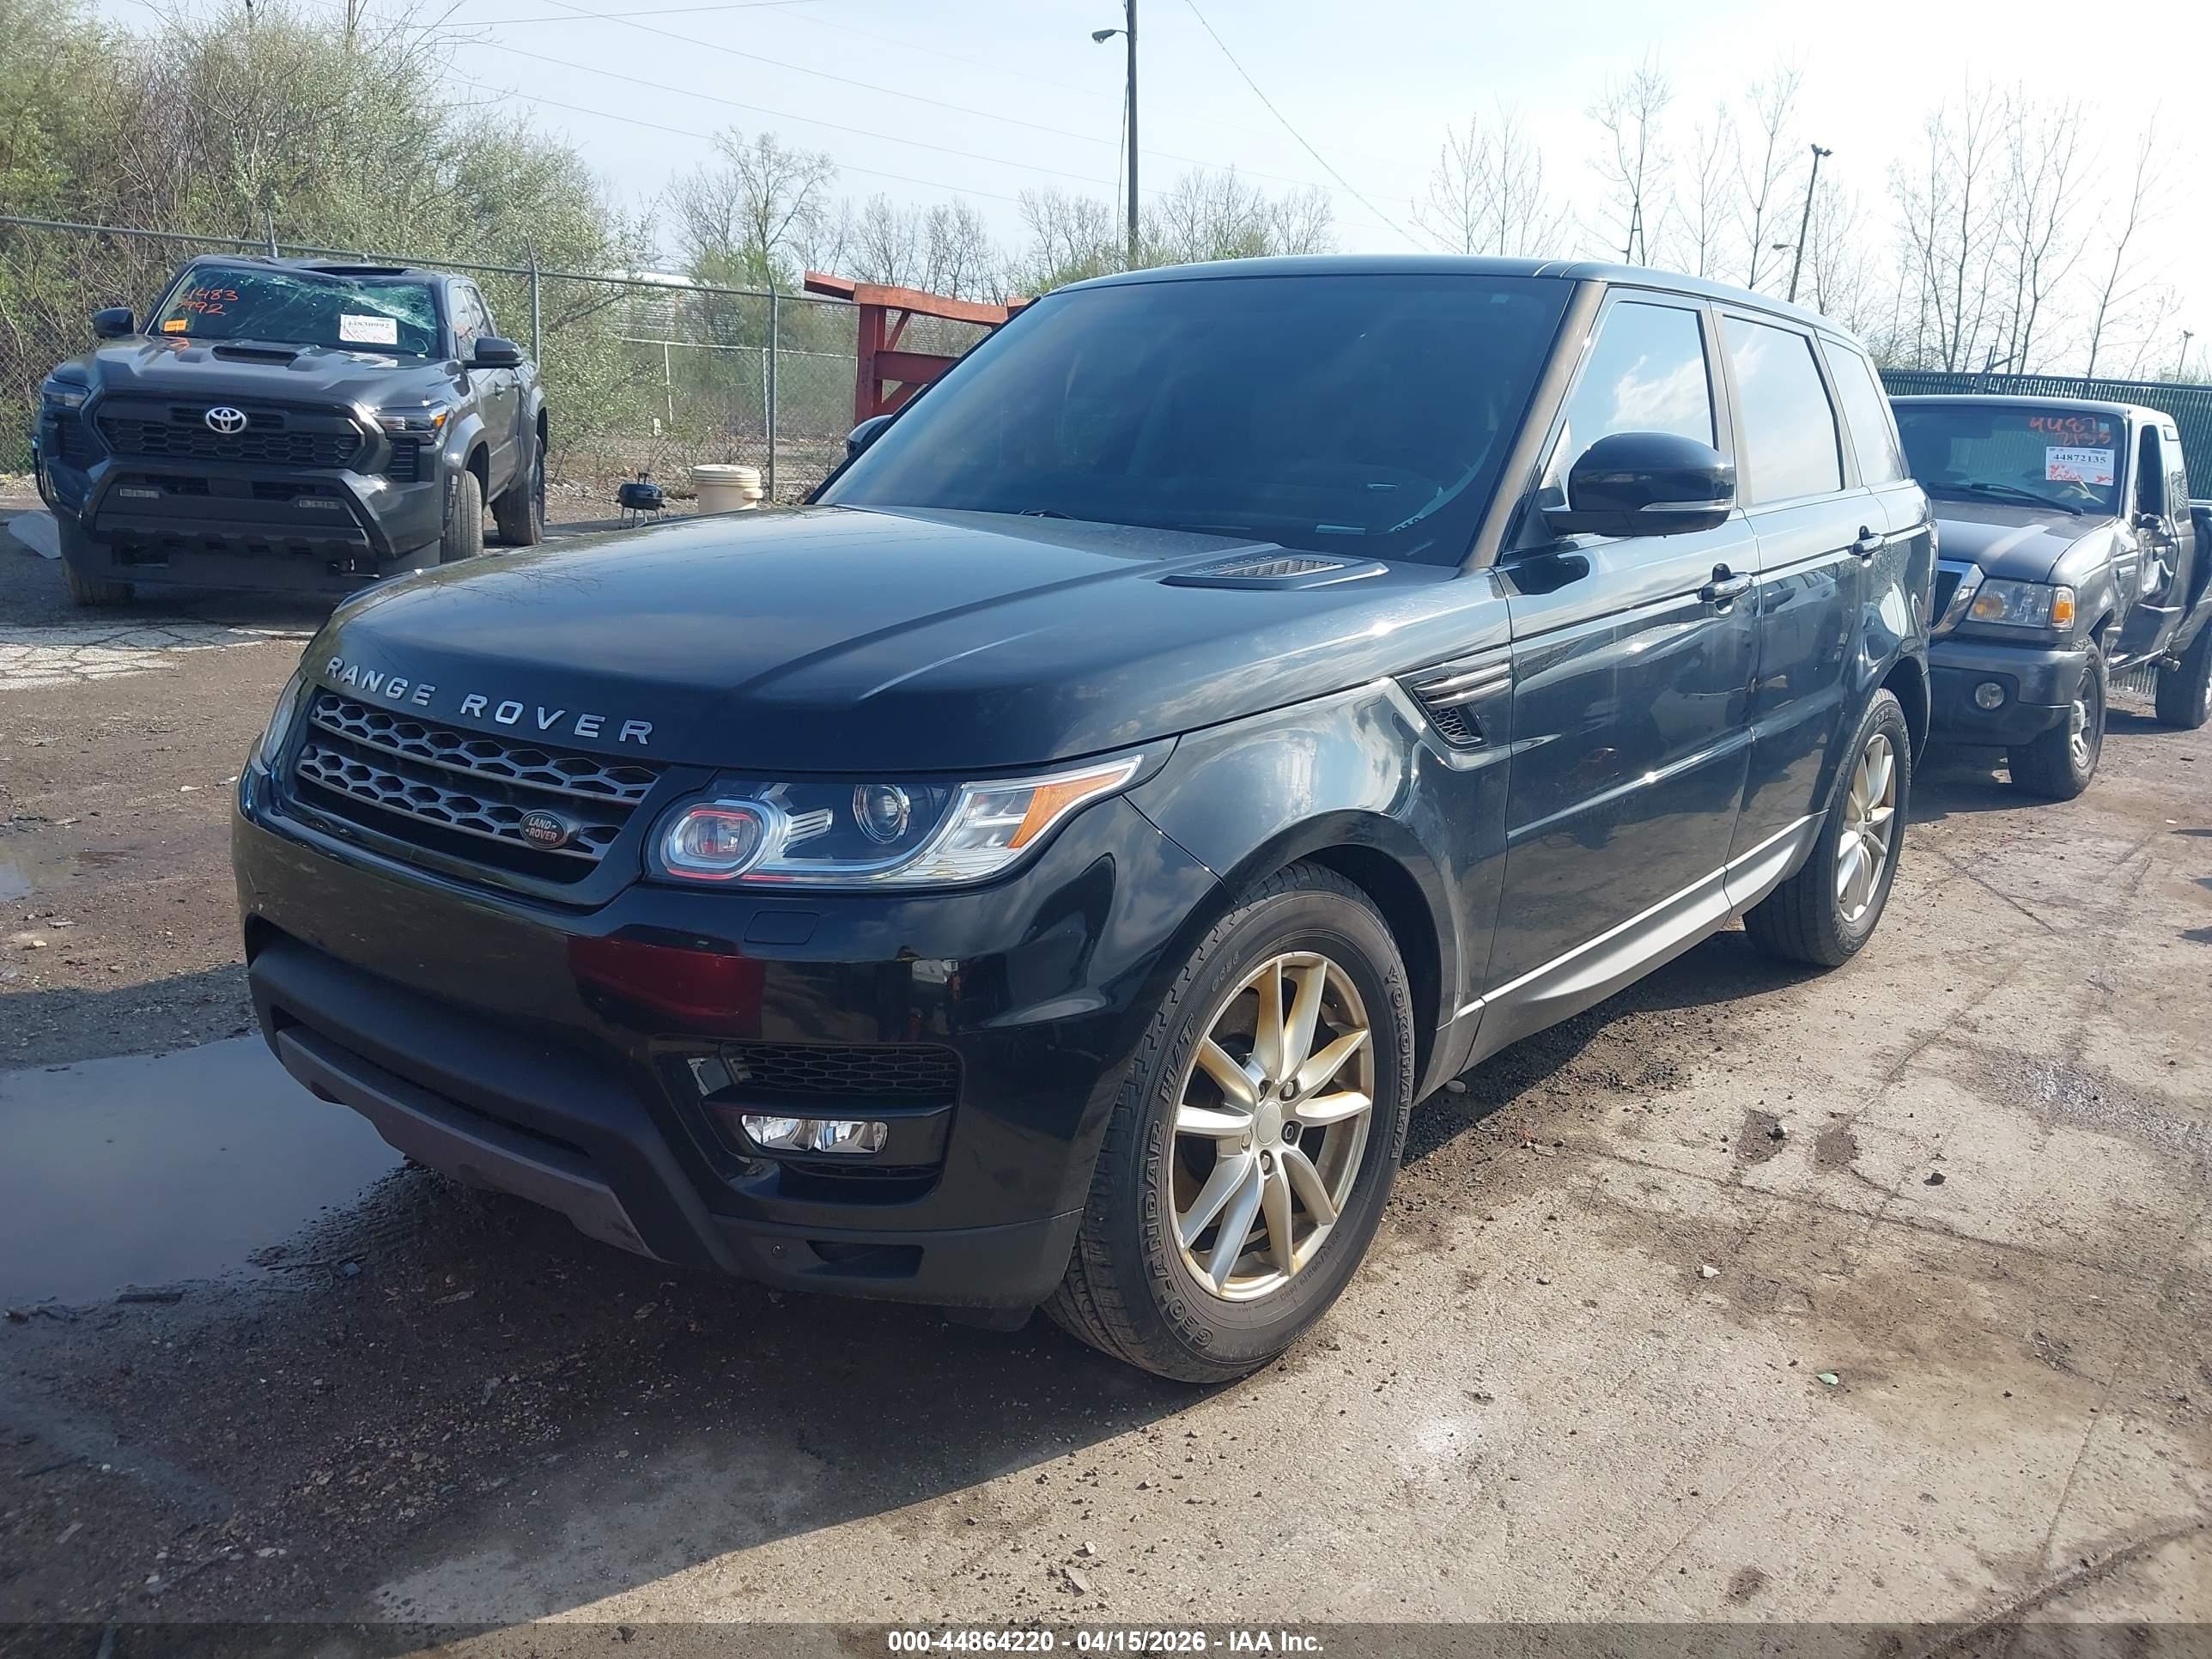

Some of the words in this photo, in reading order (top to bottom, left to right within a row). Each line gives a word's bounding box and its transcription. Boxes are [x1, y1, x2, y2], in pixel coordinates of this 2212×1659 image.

[2053, 453, 2107, 465] 44872135
[325, 656, 436, 707] RANGE
[459, 693, 653, 745] ROVER
[529, 817, 552, 830] LAND
[529, 828, 558, 842] ROVER
[1159, 1012, 1194, 1103] H/T
[1384, 963, 1411, 1159] YOKOHAMA
[1145, 1120, 1213, 1349] GEOLANDAR
